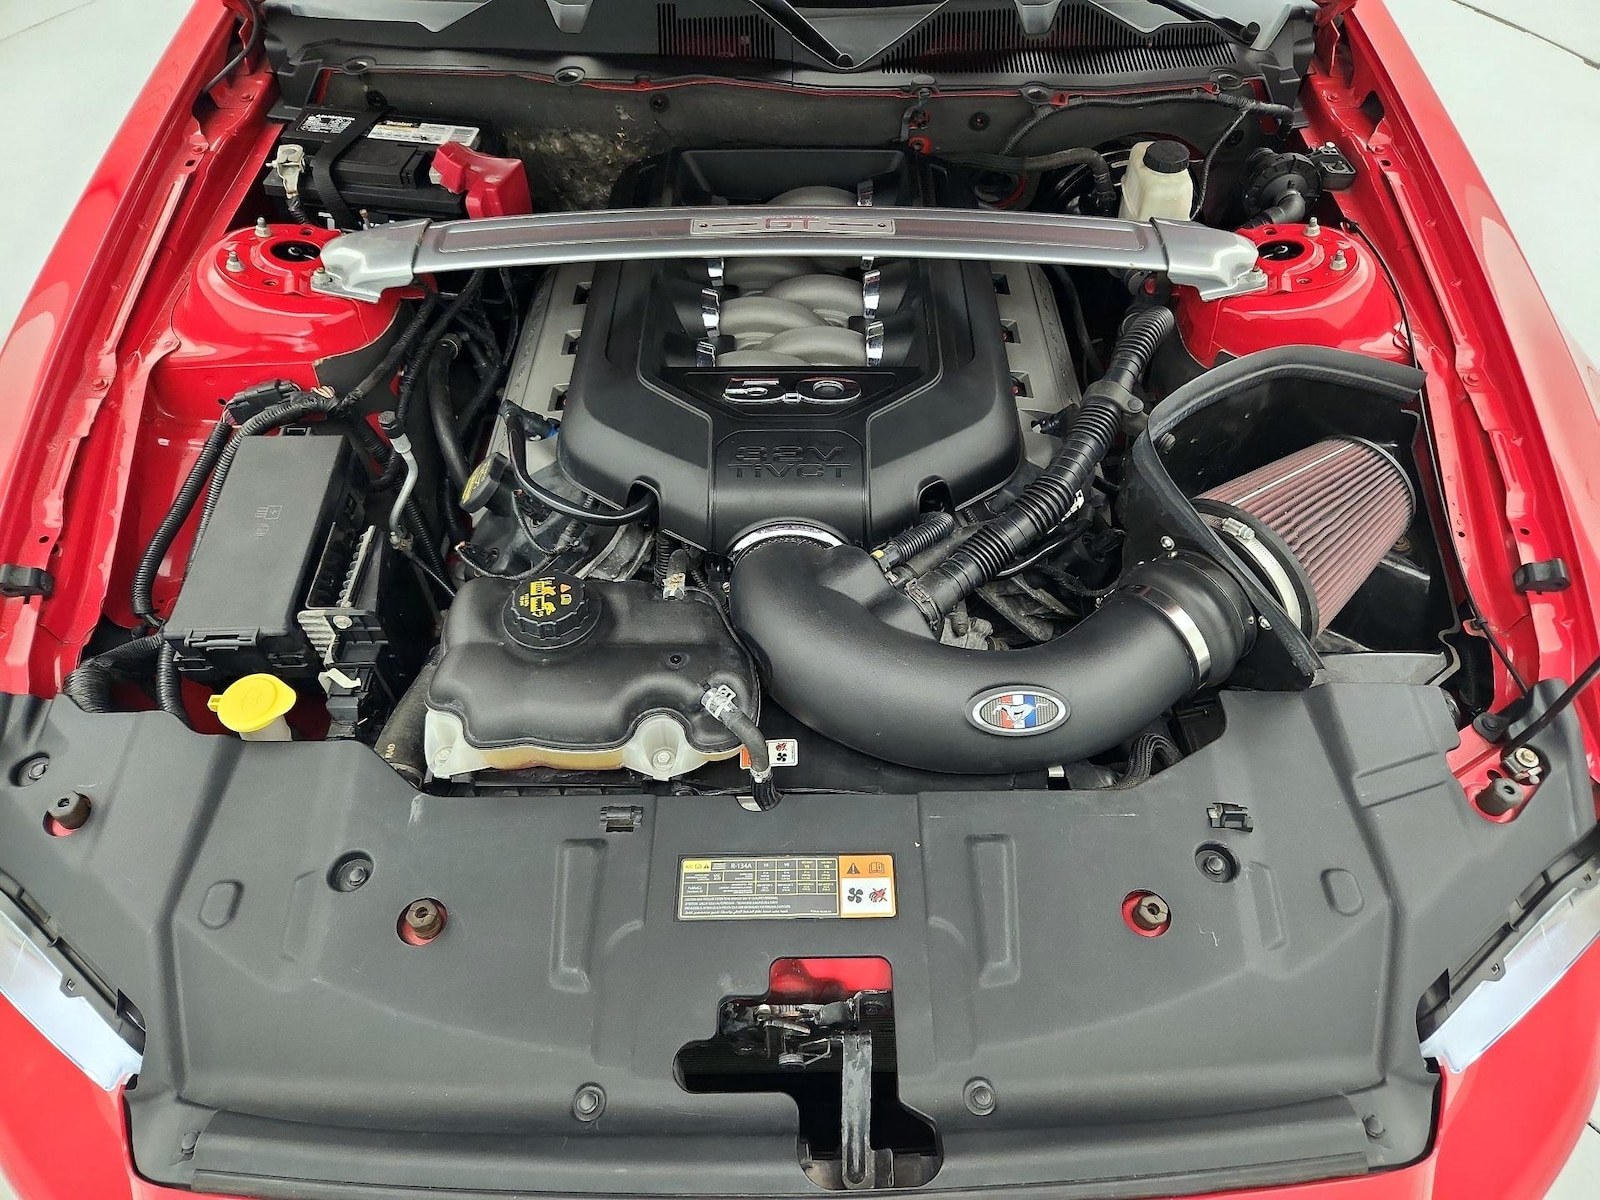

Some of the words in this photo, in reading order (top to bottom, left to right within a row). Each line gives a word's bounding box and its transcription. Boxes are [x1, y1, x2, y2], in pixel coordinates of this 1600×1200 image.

[765, 217, 820, 230] GT
[721, 376, 862, 405] 5.0
[735, 445, 845, 462] 32V
